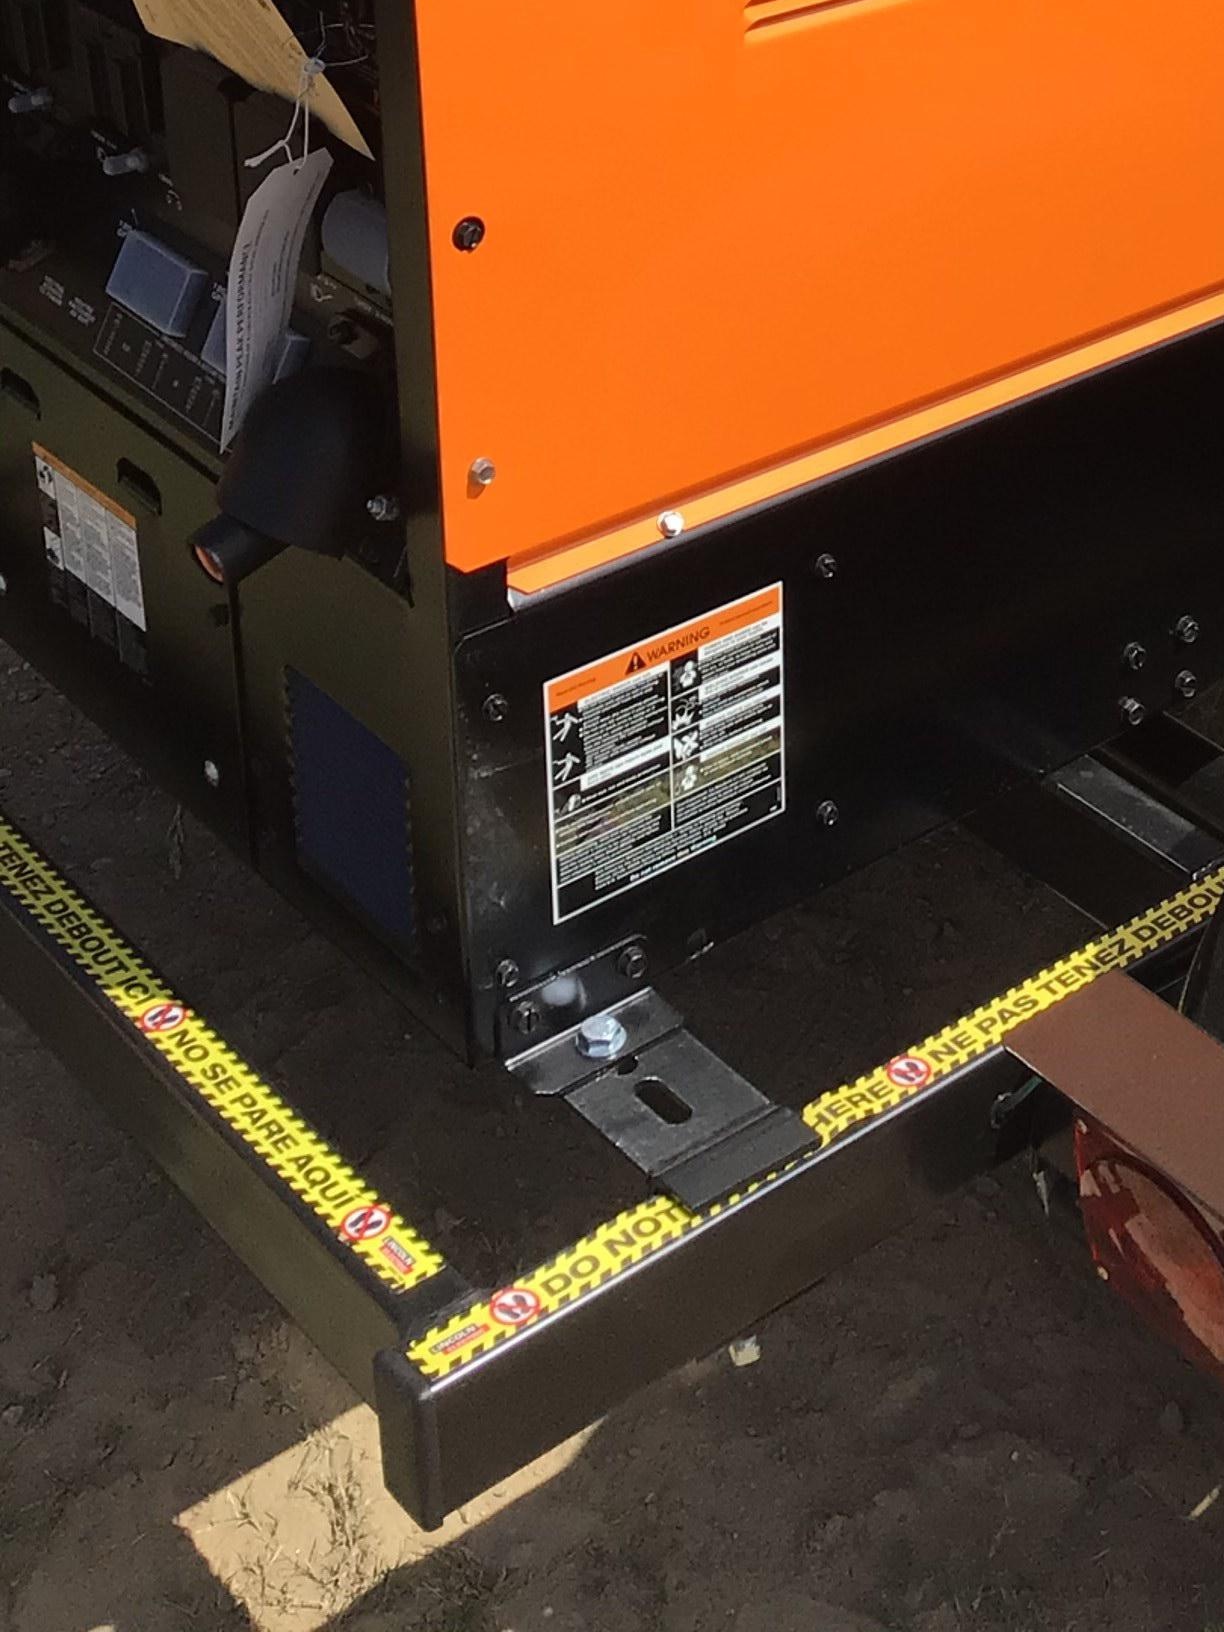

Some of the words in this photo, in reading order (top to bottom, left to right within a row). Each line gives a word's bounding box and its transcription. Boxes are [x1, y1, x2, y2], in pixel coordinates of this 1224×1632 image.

[646, 625, 711, 662] WARNING
[43, 897, 130, 977] DEBOUT
[116, 975, 155, 1006] ICI
[927, 1032, 978, 1064] NE
[975, 994, 1039, 1036] PAS
[1036, 942, 1135, 996] TENEZ
[168, 1029, 210, 1063] NO
[199, 1060, 242, 1096] SE
[229, 1090, 300, 1155] PARE
[813, 1080, 894, 1128] HERE
[540, 1254, 600, 1296] DO
[603, 1207, 682, 1258] NOT
[431, 1323, 478, 1355] LINCOLN
